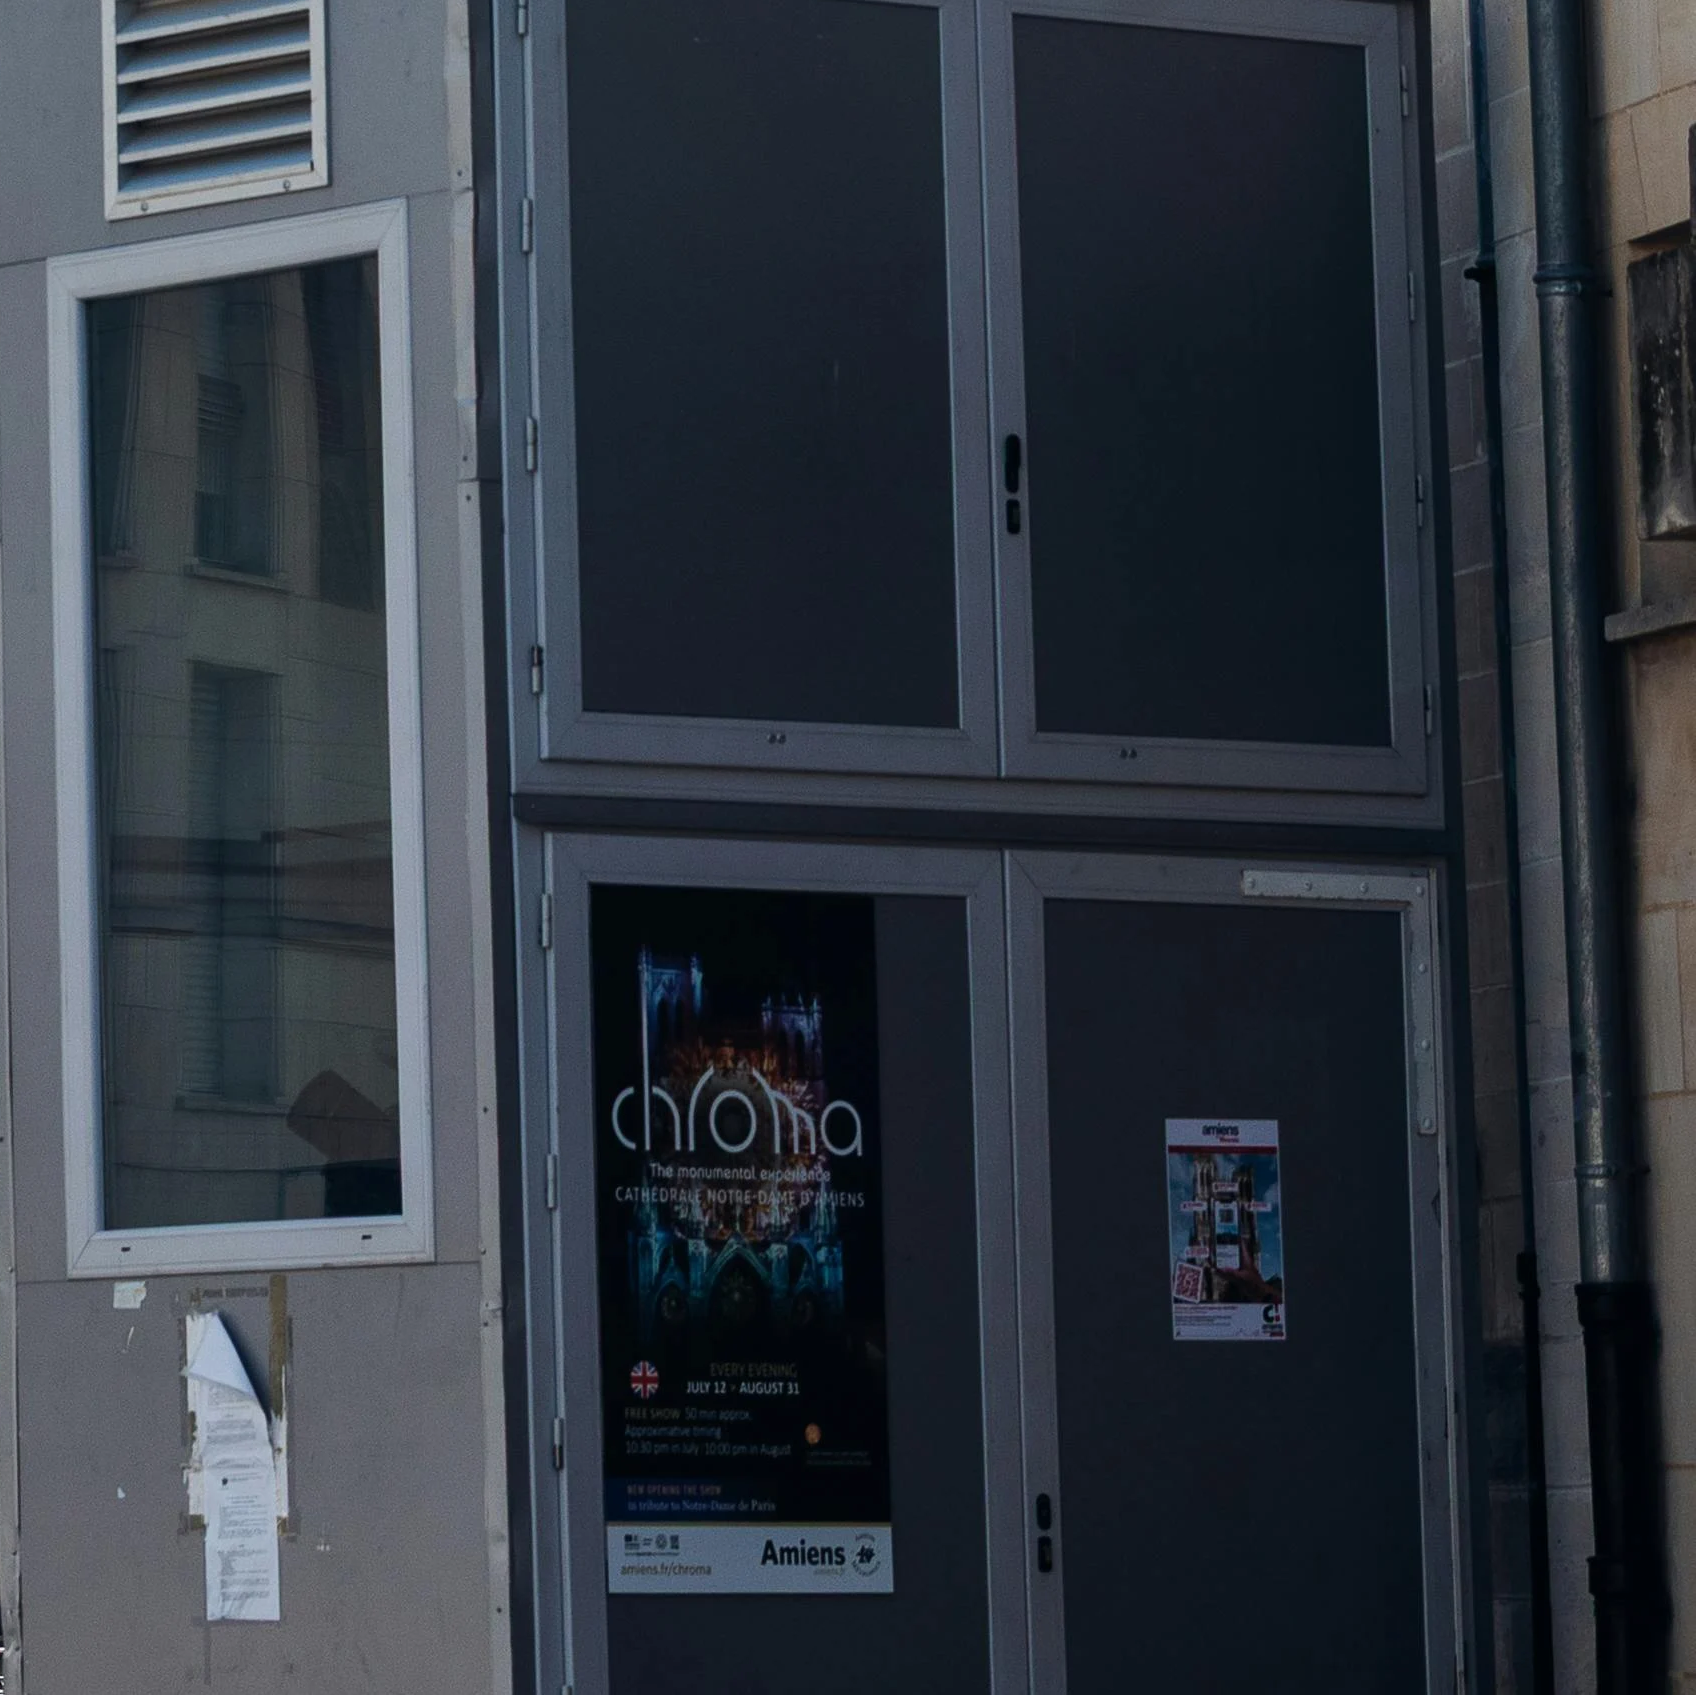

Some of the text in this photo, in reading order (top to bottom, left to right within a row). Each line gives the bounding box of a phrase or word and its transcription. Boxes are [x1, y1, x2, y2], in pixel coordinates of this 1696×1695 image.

[650, 1162, 832, 1184] The monumental experience
[707, 1187, 796, 1205] NOTRE-DAME
[710, 1361, 798, 1378] EVERY EVENING
[686, 1380, 801, 1396] JULY 12 AUGUST 31
[624, 1406, 648, 1420] FREE
[650, 1407, 682, 1421] SHOW
[684, 1406, 698, 1421] 50
[624, 1424, 691, 1439] Approximative
[760, 1443, 792, 1458] August
[737, 1498, 749, 1512] de
[751, 1498, 778, 1512] Paris
[760, 1538, 847, 1566] Amiens
[621, 1562, 712, 1576] amiens.fr/chroma
